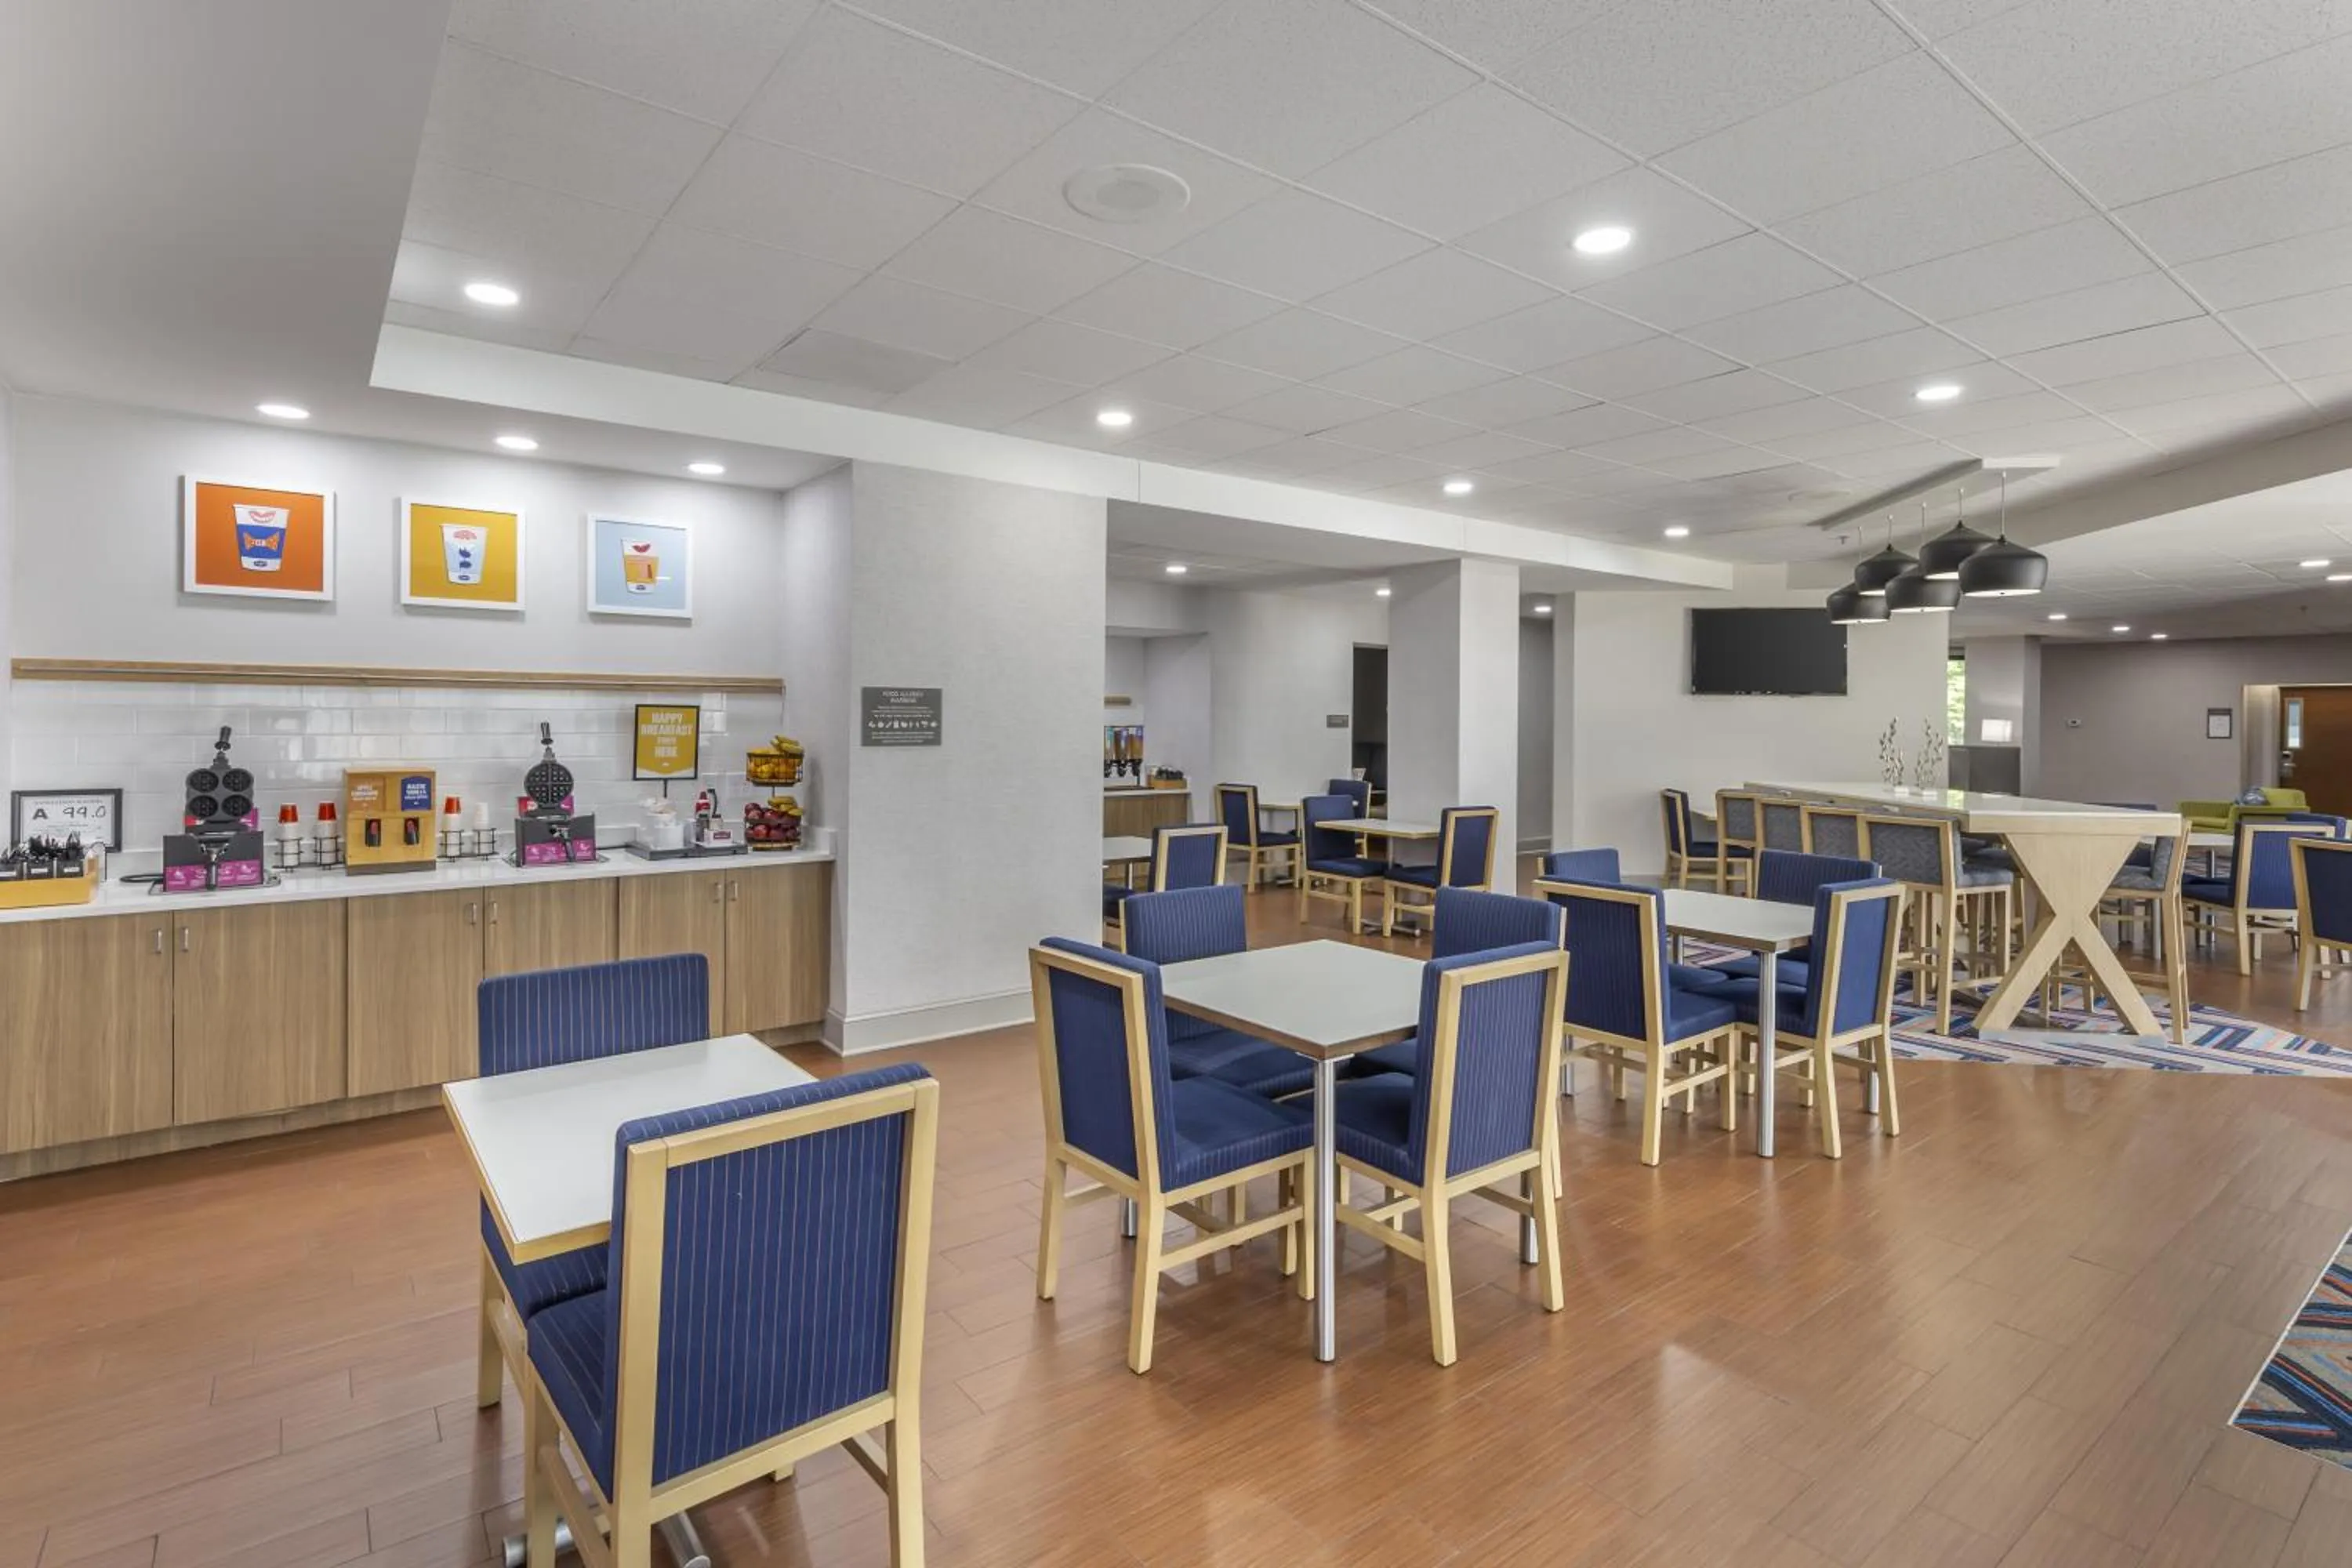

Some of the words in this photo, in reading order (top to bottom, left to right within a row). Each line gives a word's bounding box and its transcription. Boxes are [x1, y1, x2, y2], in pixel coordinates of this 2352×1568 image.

[652, 712, 684, 724] HAPPY
[641, 724, 693, 735] BREAKFAST
[32, 808, 49, 820] A
[63, 805, 107, 818] 99.0
